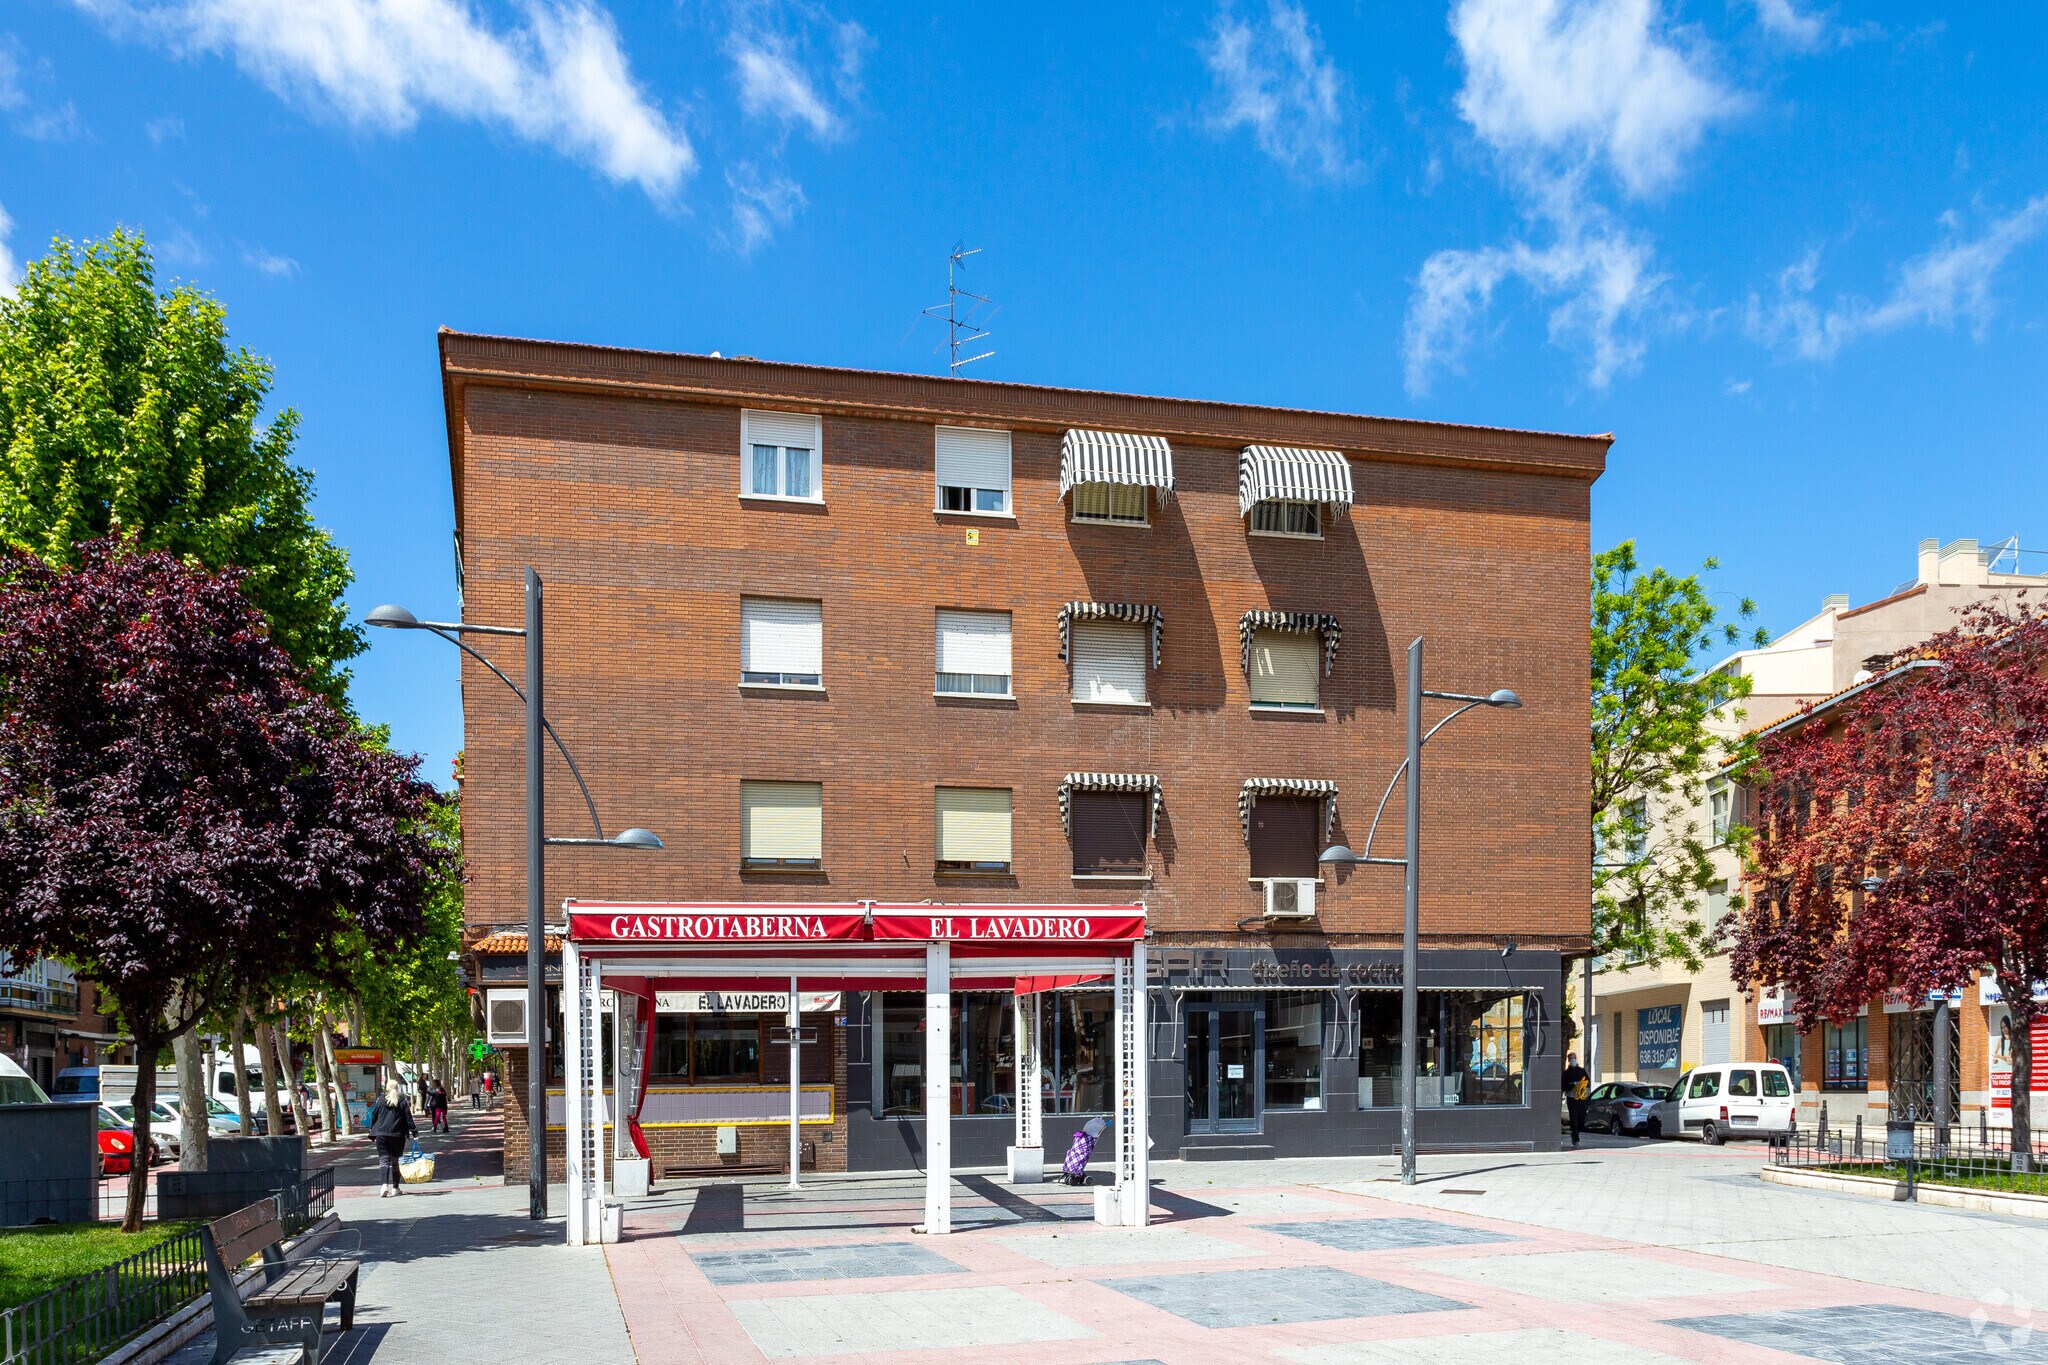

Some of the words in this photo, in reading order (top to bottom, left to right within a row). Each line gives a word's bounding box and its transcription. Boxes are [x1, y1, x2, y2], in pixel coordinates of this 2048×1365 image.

[610, 916, 827, 939] GASTROTABERNA
[929, 917, 959, 938] EL
[970, 917, 1090, 938] LAVADERO
[1251, 958, 1312, 978] diseño
[1319, 958, 1341, 978] de
[698, 994, 715, 1010] EL
[717, 994, 786, 1010] LAVADERO
[1648, 1008, 1672, 1024] LOCAL
[1760, 1007, 1783, 1019] RE/MAX
[1639, 1027, 1680, 1045] DISPONIBLE
[1652, 1049, 1664, 1063] 316
